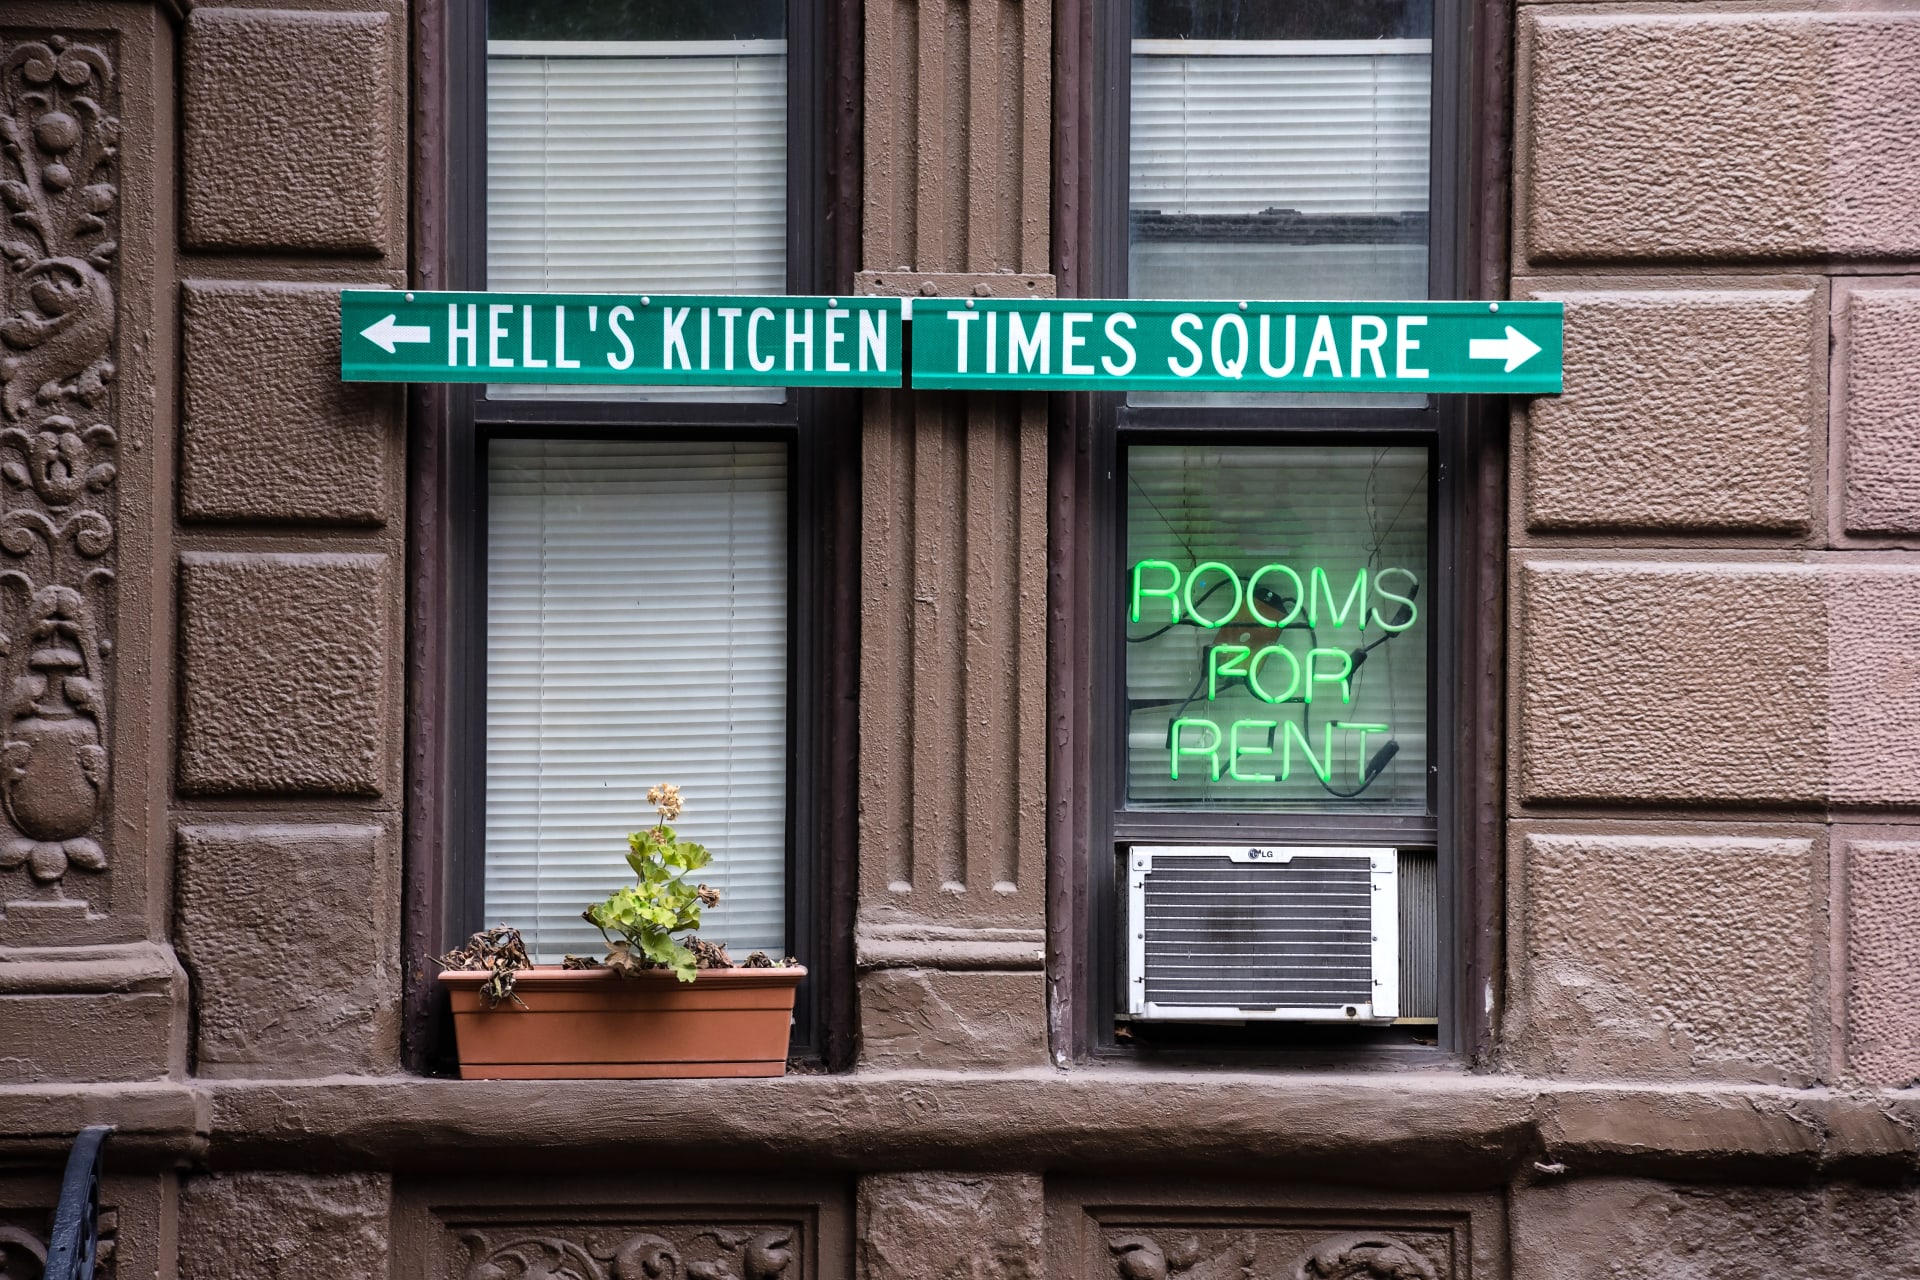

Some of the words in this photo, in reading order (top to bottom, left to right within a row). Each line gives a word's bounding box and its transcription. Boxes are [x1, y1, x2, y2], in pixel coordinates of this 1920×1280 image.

[448, 303, 635, 370] HELL'S
[663, 307, 887, 372] KITCHEN
[946, 310, 1137, 377] TIMES
[1167, 312, 1430, 380] SQUARE
[1131, 559, 1418, 632] ROOMS
[1208, 644, 1352, 704] FOR
[1170, 717, 1389, 784] RENT
